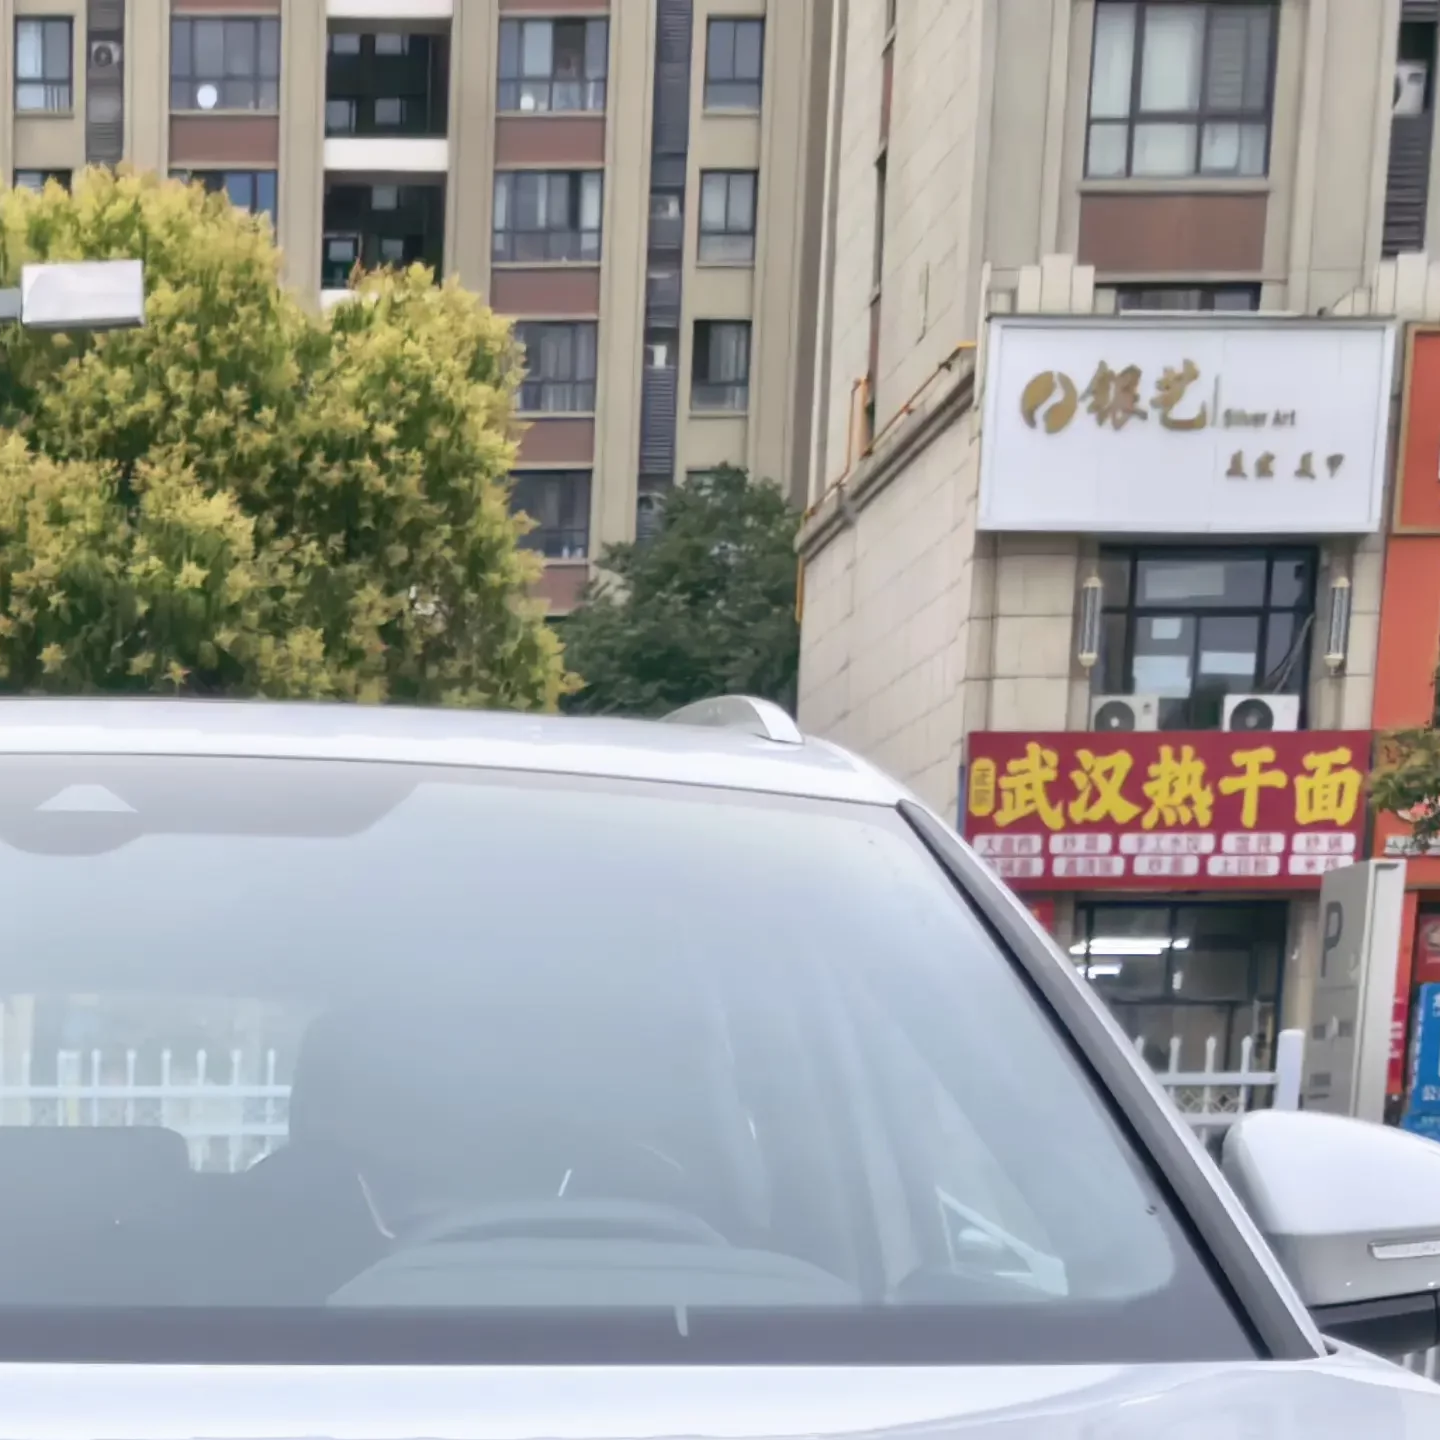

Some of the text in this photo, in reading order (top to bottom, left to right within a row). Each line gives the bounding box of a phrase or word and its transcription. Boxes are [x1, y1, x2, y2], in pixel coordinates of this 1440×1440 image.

[1079, 359, 1207, 431] 银艺
[1271, 408, 1296, 427] Art
[994, 742, 1363, 831] 武汉热干面
